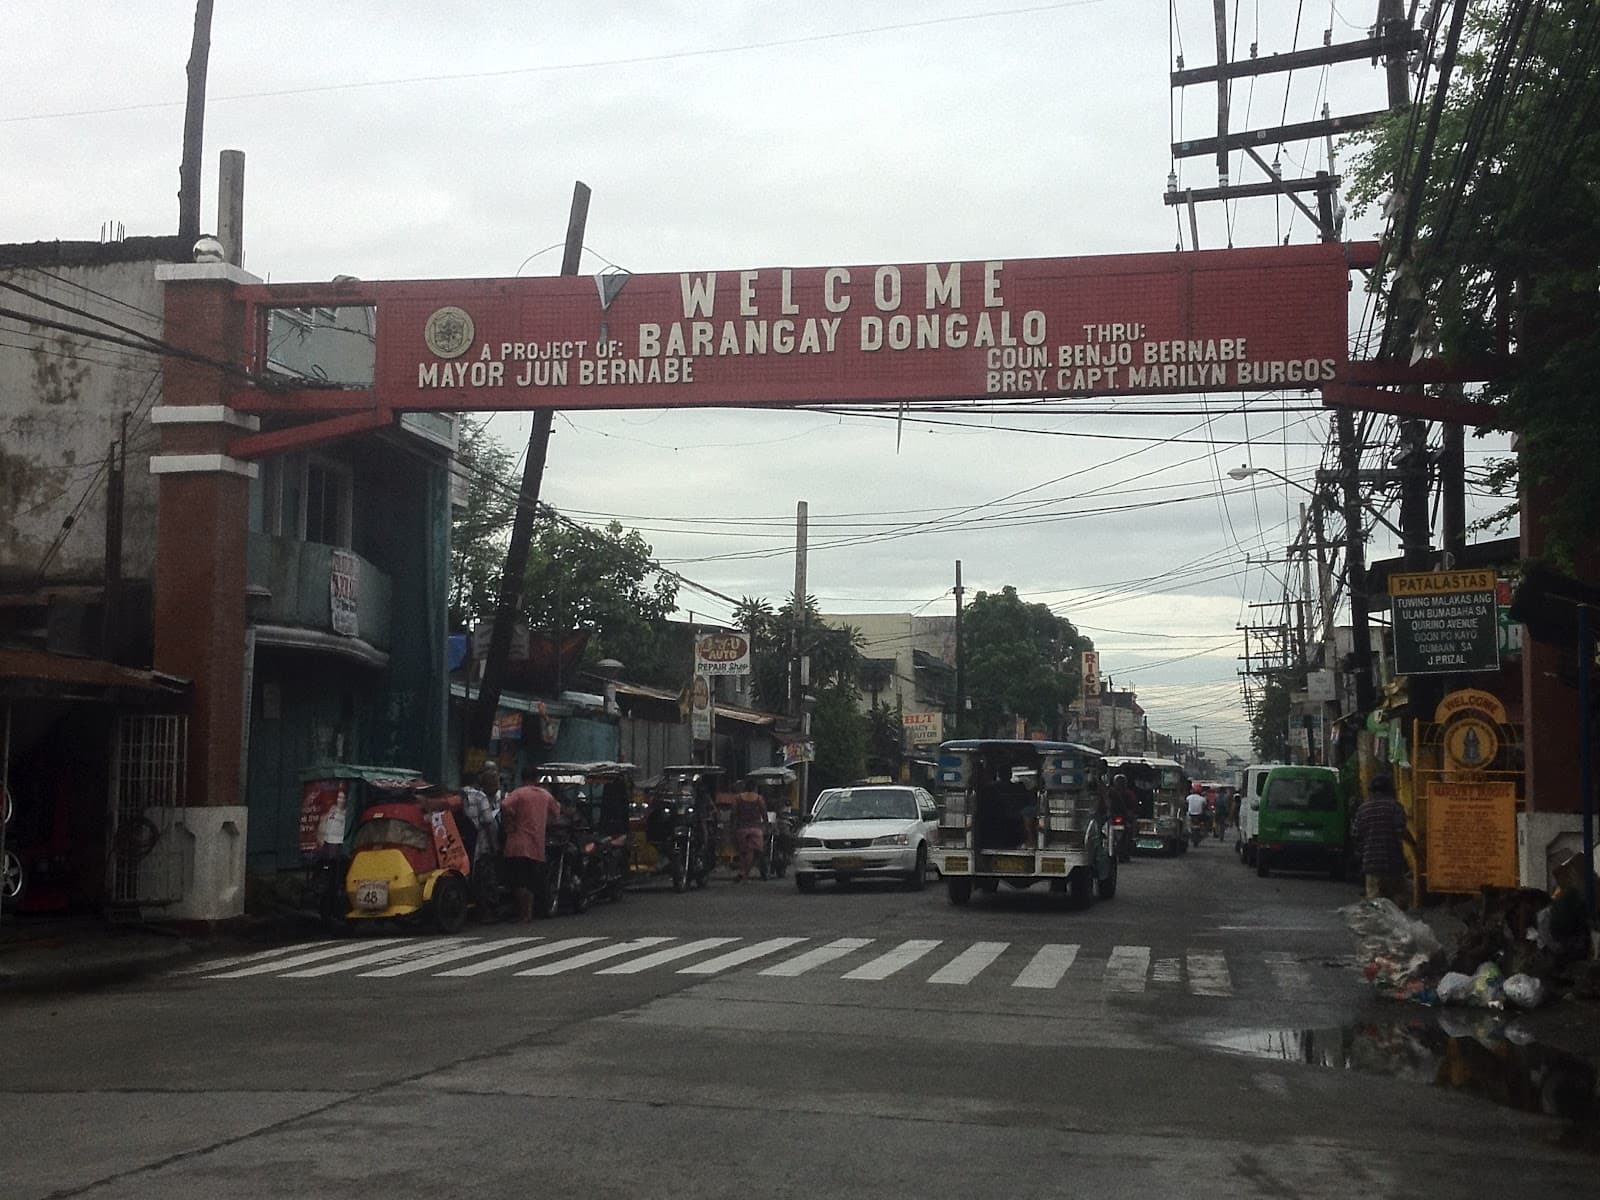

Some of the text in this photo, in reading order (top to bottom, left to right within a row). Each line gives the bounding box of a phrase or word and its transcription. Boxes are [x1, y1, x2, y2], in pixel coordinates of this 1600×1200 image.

[679, 260, 1004, 319] WELCOME
[638, 309, 1047, 358] BARANGAY DONGALO
[1082, 323, 1146, 343] THRU:
[479, 338, 624, 361] A PROJECT OF:
[986, 338, 1247, 370] COUN. BENJO BERNABE
[418, 357, 694, 388] MAYOR JUN BERNABE
[986, 358, 1336, 393] BRGY. CAPT. MARILYN BURGOS
[1399, 574, 1487, 591] PATALASTAS
[1398, 593, 1492, 608] TUWING MALAKAS ANG
[1402, 606, 1487, 620] ULAN BUMABAHA SA
[1411, 618, 1479, 631] QUIRINO AVENUE
[708, 649, 738, 660] AUTO
[1461, 641, 1473, 652] SA
[697, 662, 727, 672] REPAIR
[1084, 653, 1096, 694] RICK
[1445, 695, 1498, 714] WELCOME
